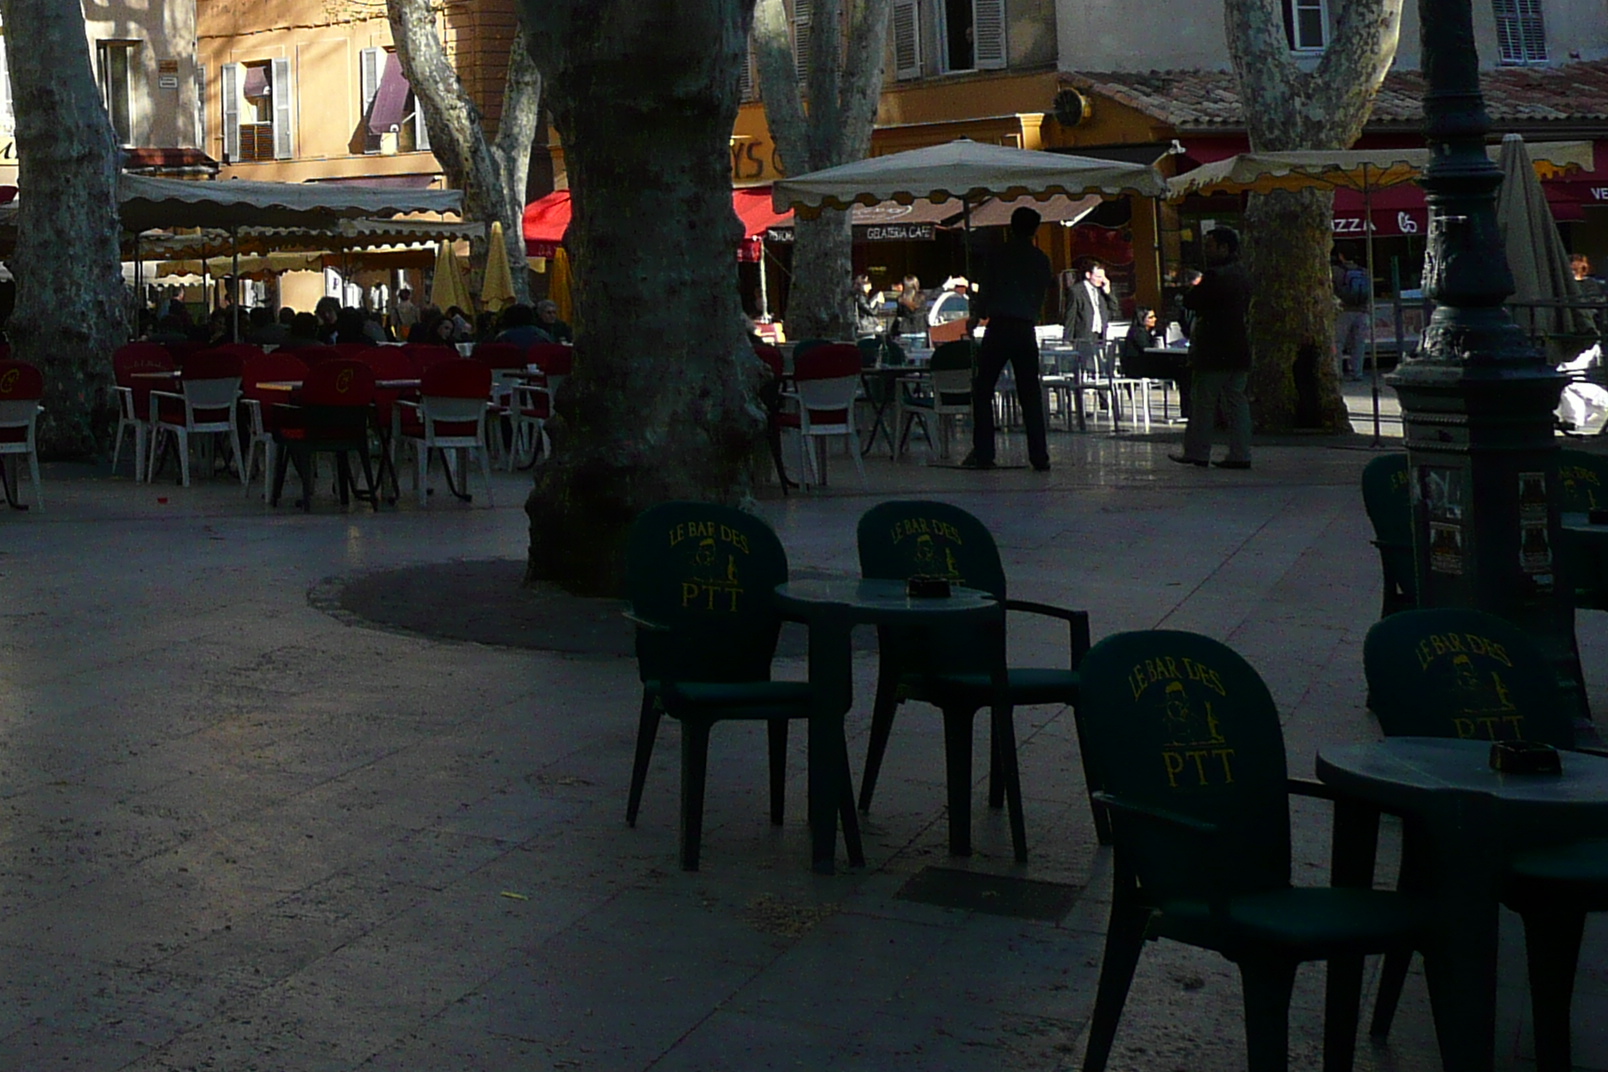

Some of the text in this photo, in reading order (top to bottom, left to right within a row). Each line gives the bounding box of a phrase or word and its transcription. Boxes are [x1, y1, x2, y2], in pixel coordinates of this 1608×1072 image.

[1330, 217, 1377, 232] IZZA
[668, 521, 750, 555] LE BAR DES
[903, 517, 929, 535] BAR
[932, 519, 963, 545] DES
[681, 581, 744, 613] PTT
[1414, 632, 1513, 671] LE BAR DES
[1128, 655, 1227, 703] LE BAR DES
[1161, 748, 1236, 789] PTT
